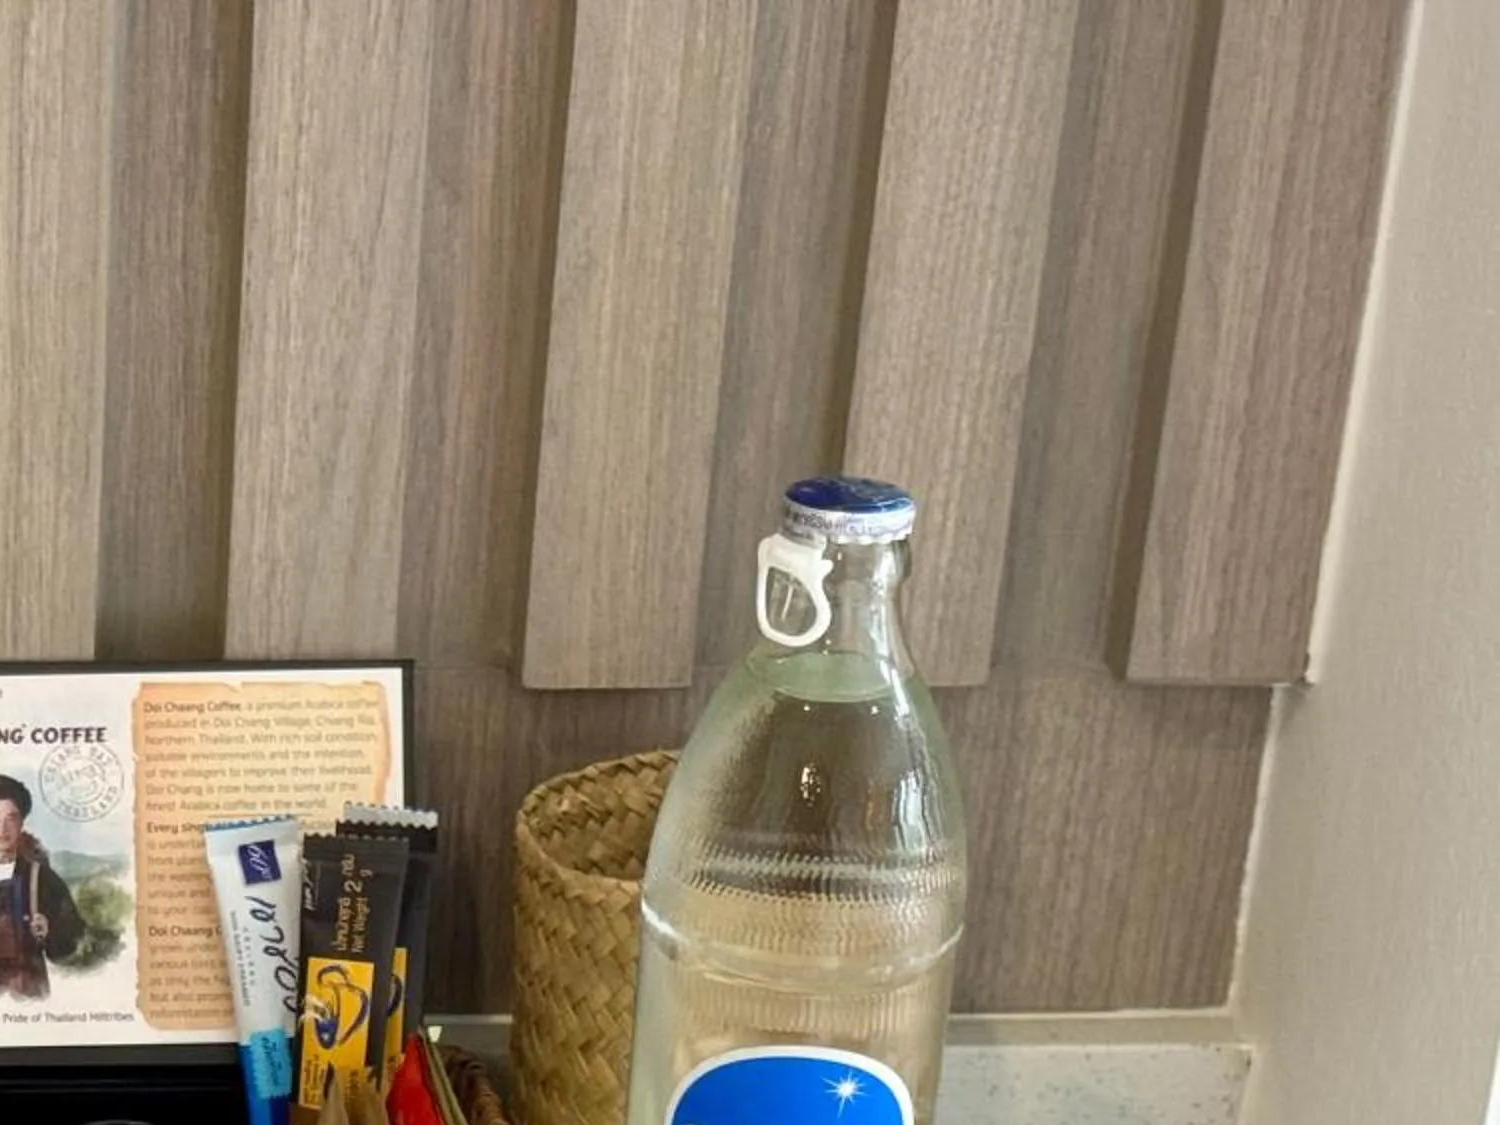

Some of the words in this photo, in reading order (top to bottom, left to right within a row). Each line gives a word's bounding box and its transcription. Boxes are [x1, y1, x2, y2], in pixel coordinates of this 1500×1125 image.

[31, 726, 108, 745] COFFEE
[147, 822, 179, 834] Every
[344, 879, 363, 893] 2
